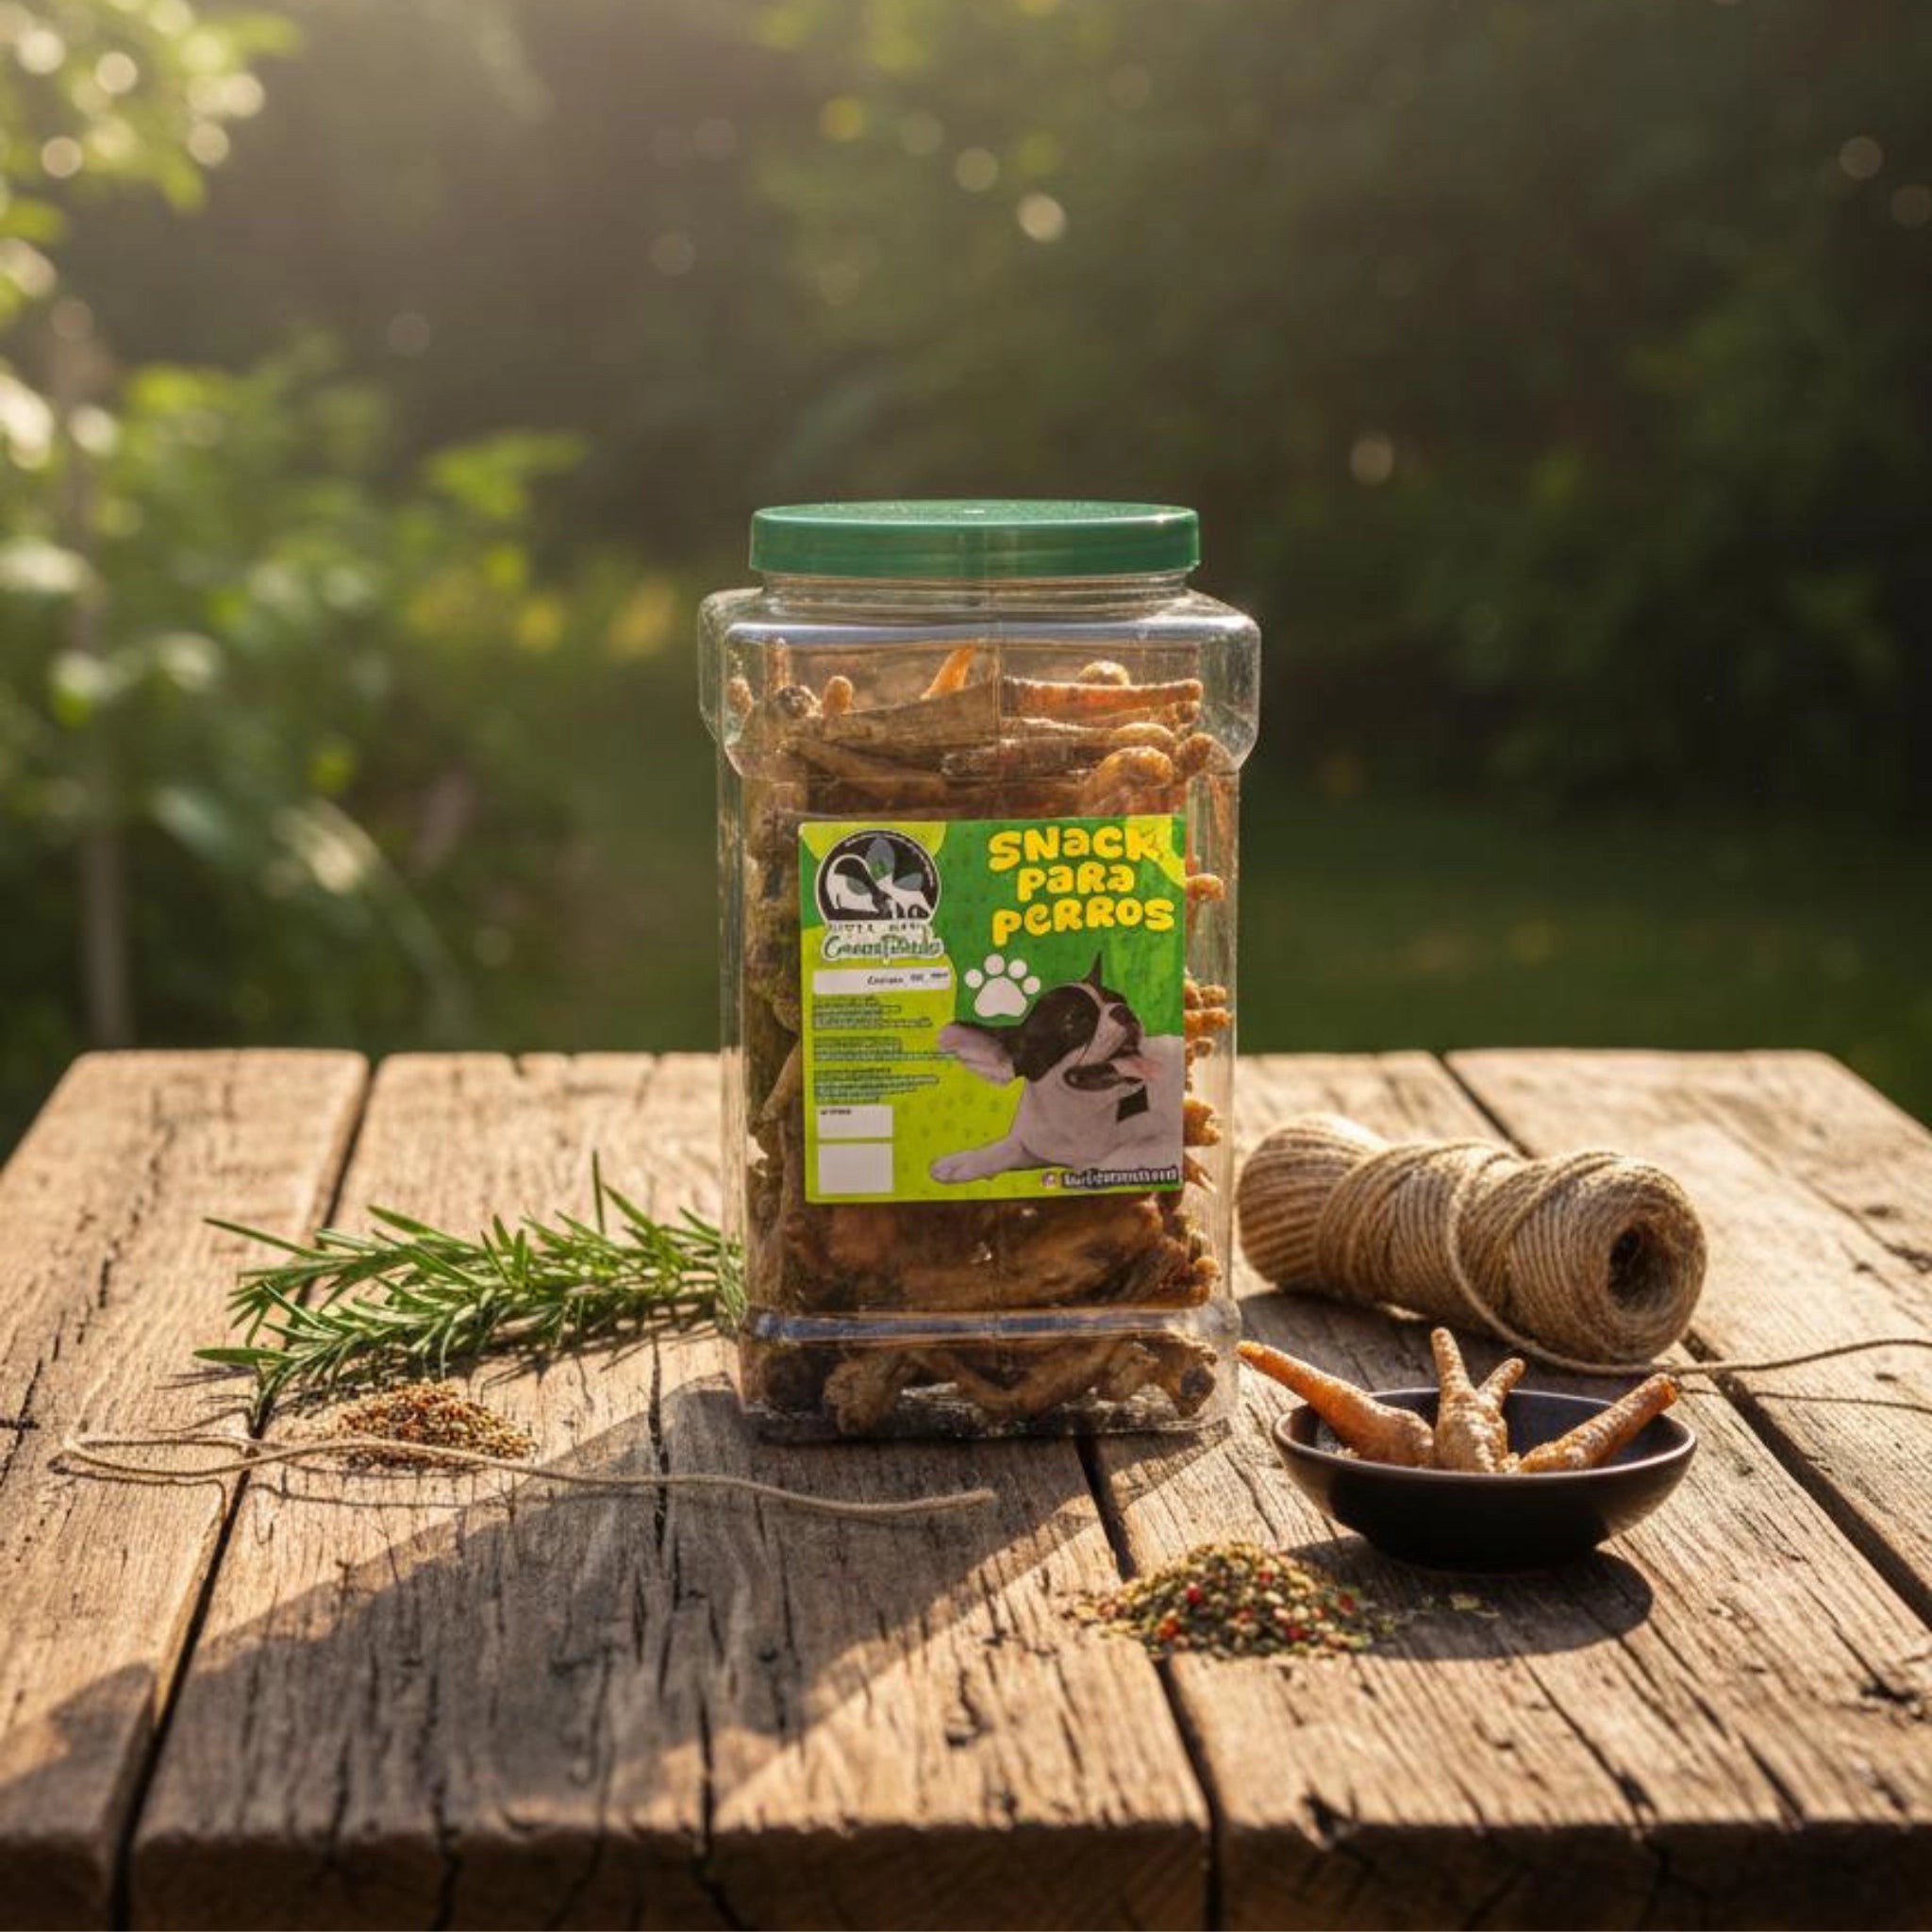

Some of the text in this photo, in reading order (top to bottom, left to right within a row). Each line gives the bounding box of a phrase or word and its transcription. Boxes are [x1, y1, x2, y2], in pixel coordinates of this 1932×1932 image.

[989, 825, 1160, 872] SNACK
[1017, 861, 1135, 902] PARA
[992, 896, 1174, 946] PERROS
